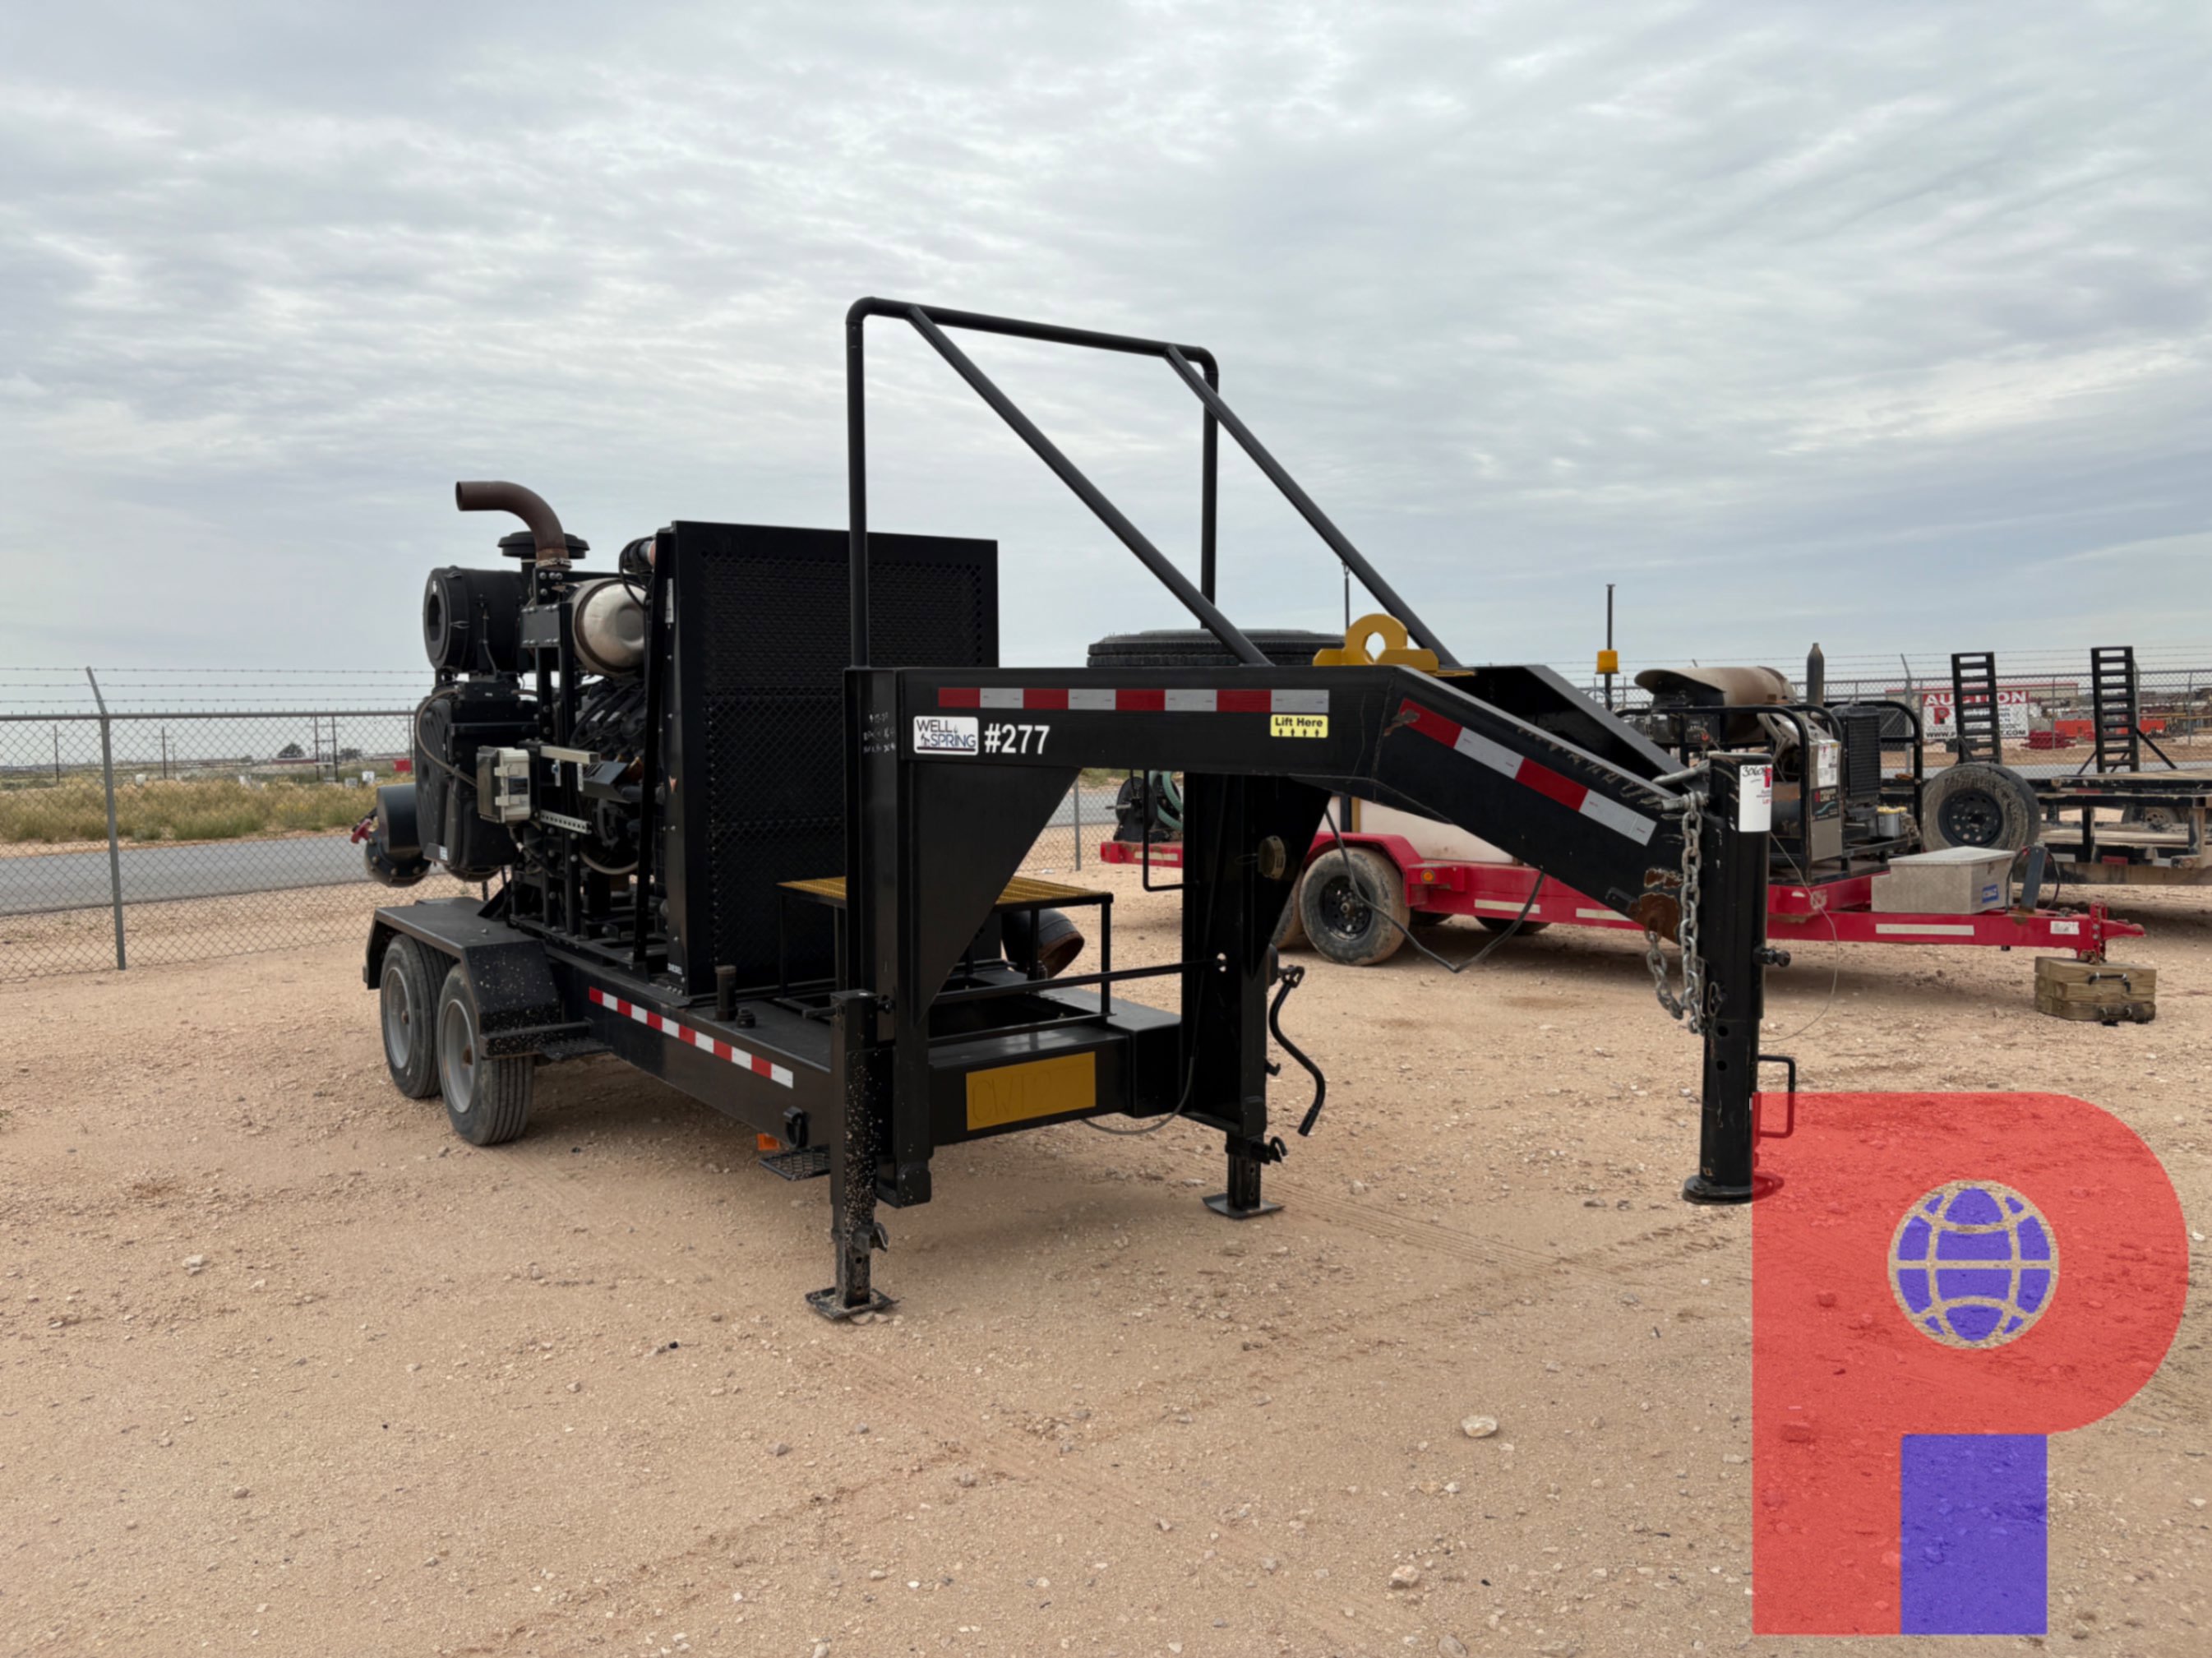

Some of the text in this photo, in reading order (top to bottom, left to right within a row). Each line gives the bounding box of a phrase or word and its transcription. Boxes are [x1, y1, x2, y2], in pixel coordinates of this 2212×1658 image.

[916, 718, 953, 732] WELL
[1275, 717, 1323, 727] Lift Here
[931, 734, 977, 747] SPRING
[984, 723, 1051, 755] #277
